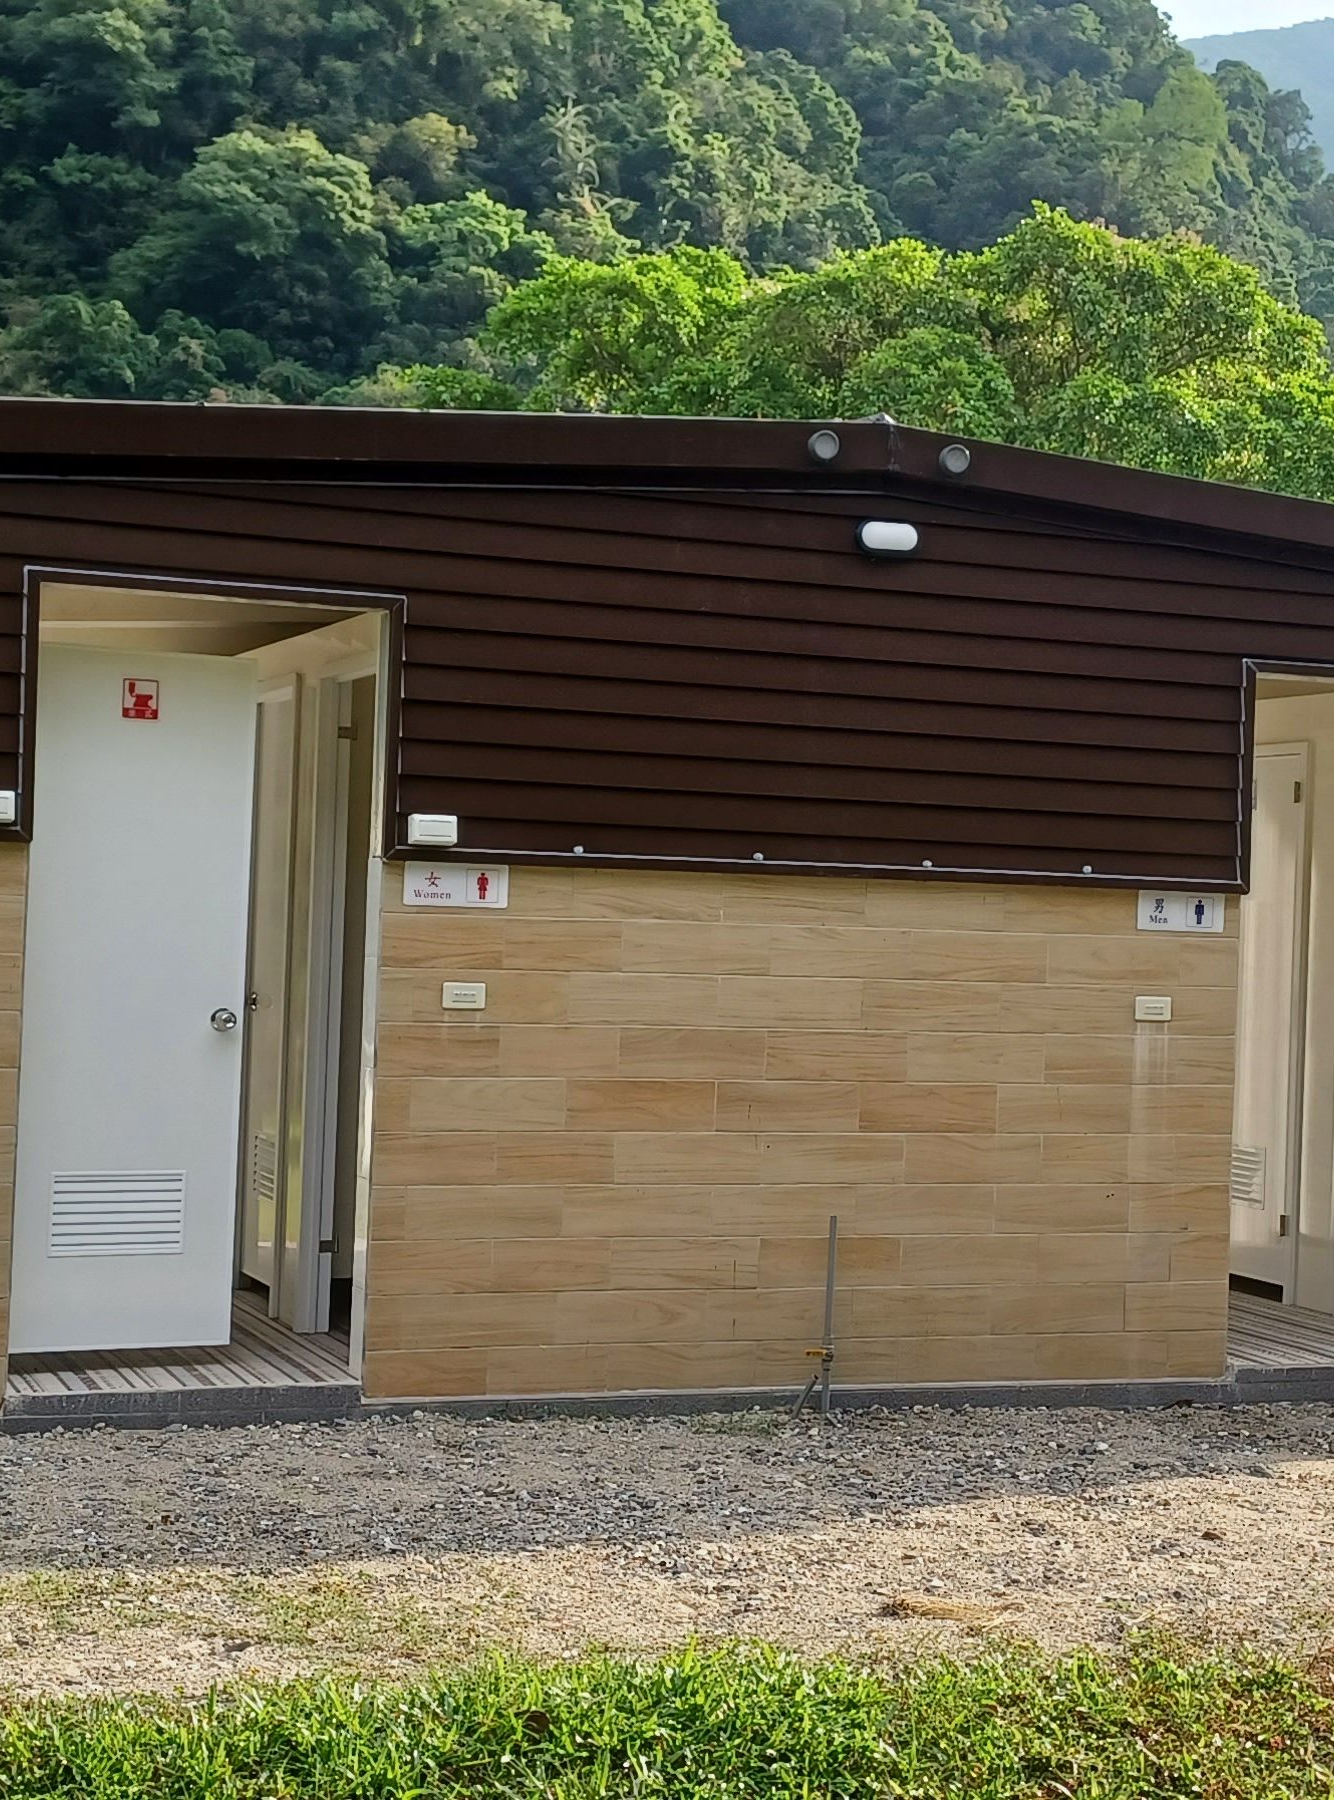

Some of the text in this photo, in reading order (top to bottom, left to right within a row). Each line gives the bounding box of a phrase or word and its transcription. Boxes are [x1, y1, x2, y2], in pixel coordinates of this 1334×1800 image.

[424, 871, 442, 888] 女
[413, 889, 452, 900] Women
[1153, 898, 1165, 914] 男
[1149, 914, 1169, 924] Men
